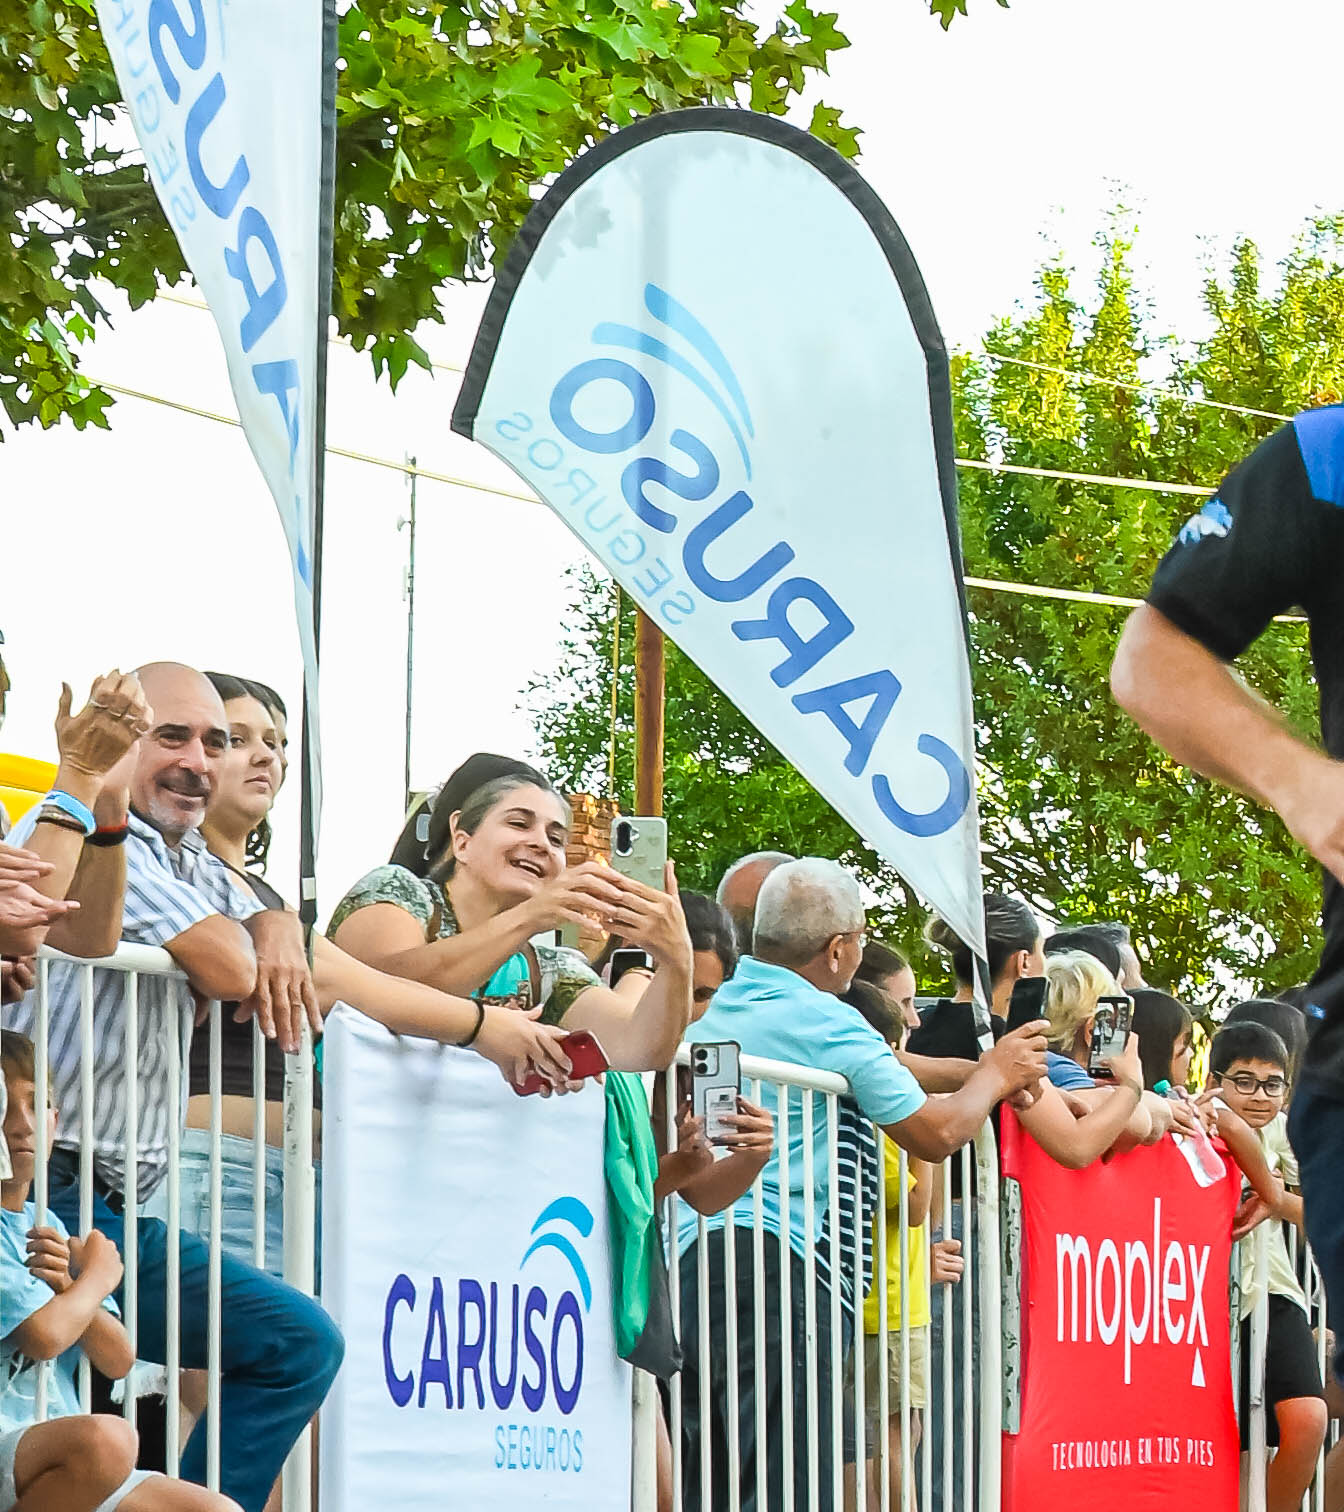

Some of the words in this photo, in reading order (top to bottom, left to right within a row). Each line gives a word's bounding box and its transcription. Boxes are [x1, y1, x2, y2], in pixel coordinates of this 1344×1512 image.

[1056, 1197, 1211, 1385] moplex
[383, 1274, 584, 1414] CARUSO
[494, 1425, 584, 1473] SEGUROS
[1052, 1441, 1131, 1471] TECNOLOGIA
[1138, 1439, 1152, 1465] EN
[1158, 1437, 1180, 1464] TUS
[1187, 1440, 1214, 1466] PIES
